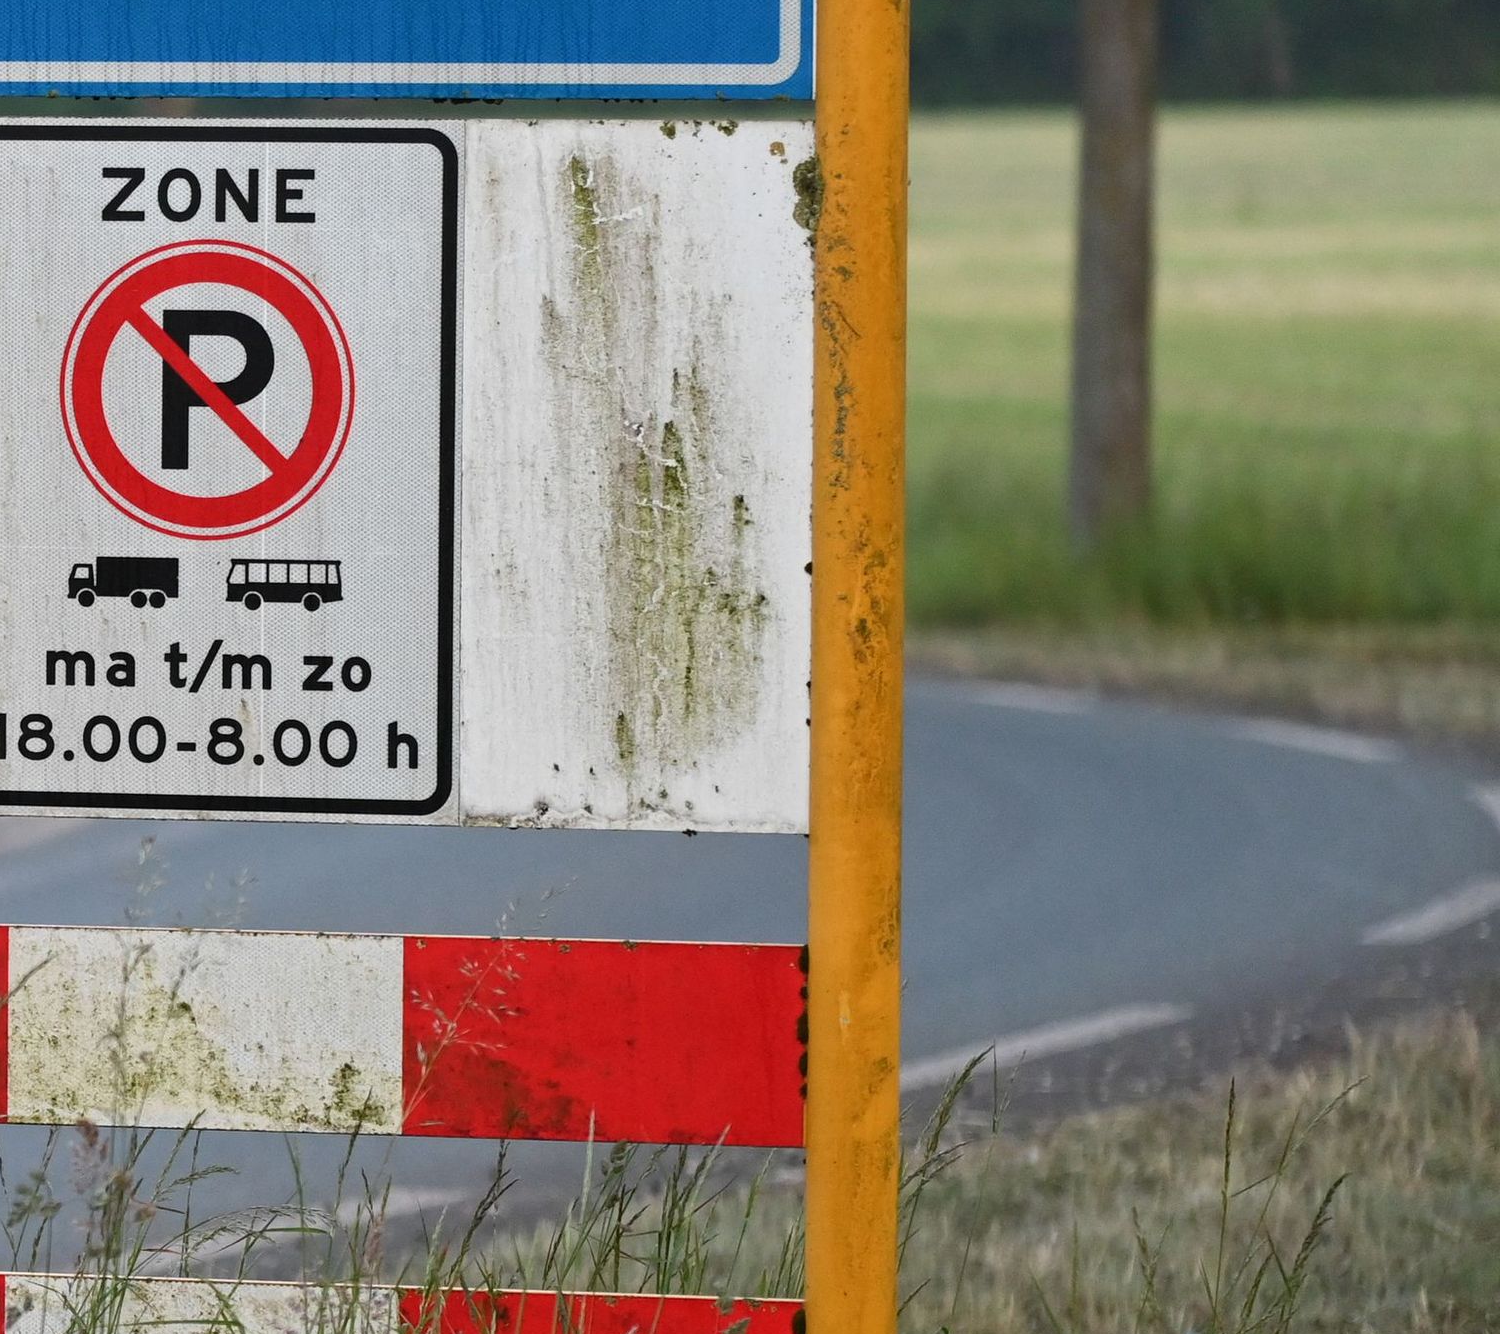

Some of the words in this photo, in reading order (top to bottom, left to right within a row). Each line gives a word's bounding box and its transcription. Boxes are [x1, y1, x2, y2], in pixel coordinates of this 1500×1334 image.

[101, 167, 316, 224] ZONE
[161, 310, 275, 469] P
[45, 648, 136, 687] ma
[164, 639, 272, 693] t/m
[302, 655, 372, 693] zo
[387, 721, 419, 769] h
